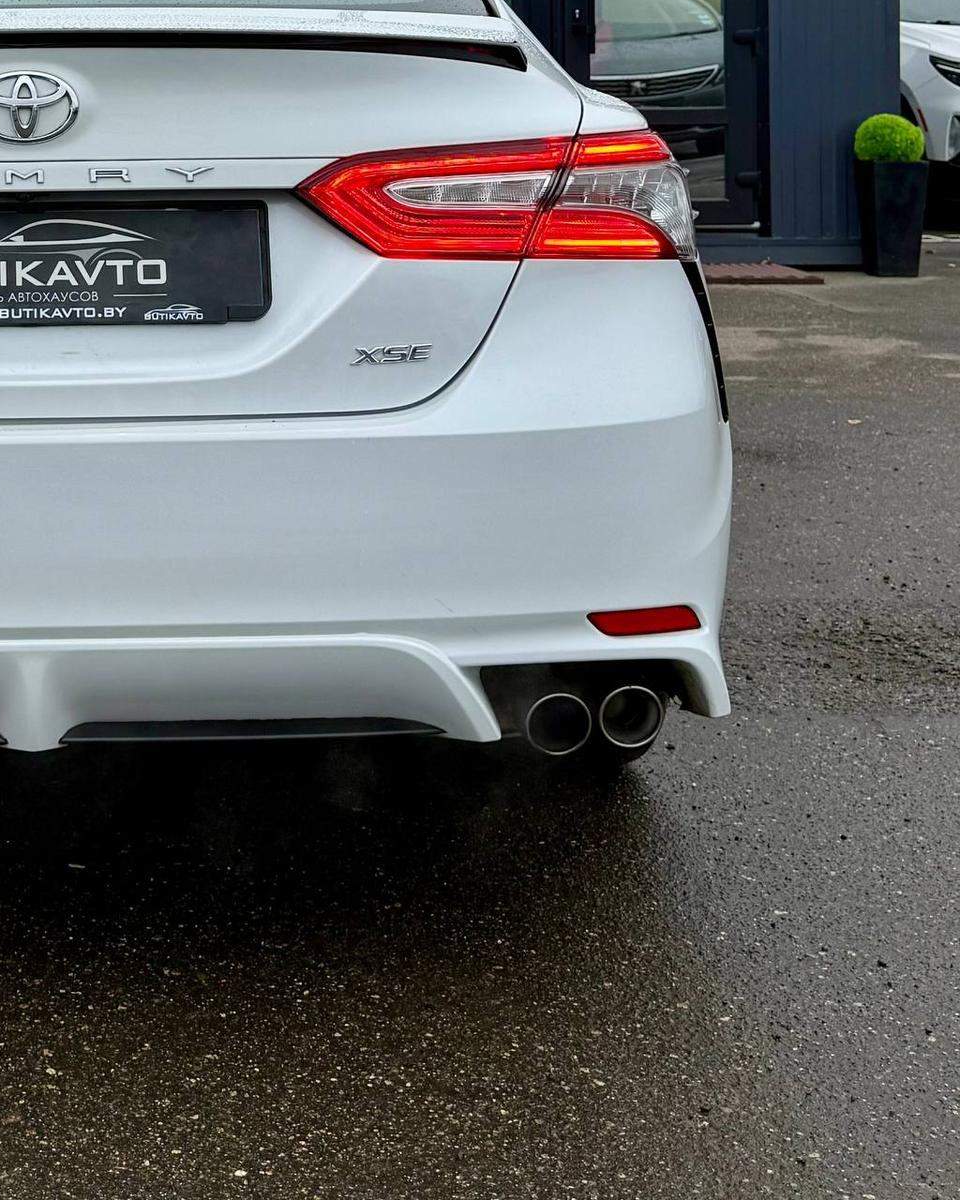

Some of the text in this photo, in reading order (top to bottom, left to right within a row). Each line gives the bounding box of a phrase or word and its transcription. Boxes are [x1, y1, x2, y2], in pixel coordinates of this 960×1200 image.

[7, 290, 99, 303] АВТОХАУСОВ
[0, 306, 127, 319] BUTIKAVTO.BY
[144, 312, 204, 321] BUTIKAVTO
[350, 343, 432, 366] XSE
